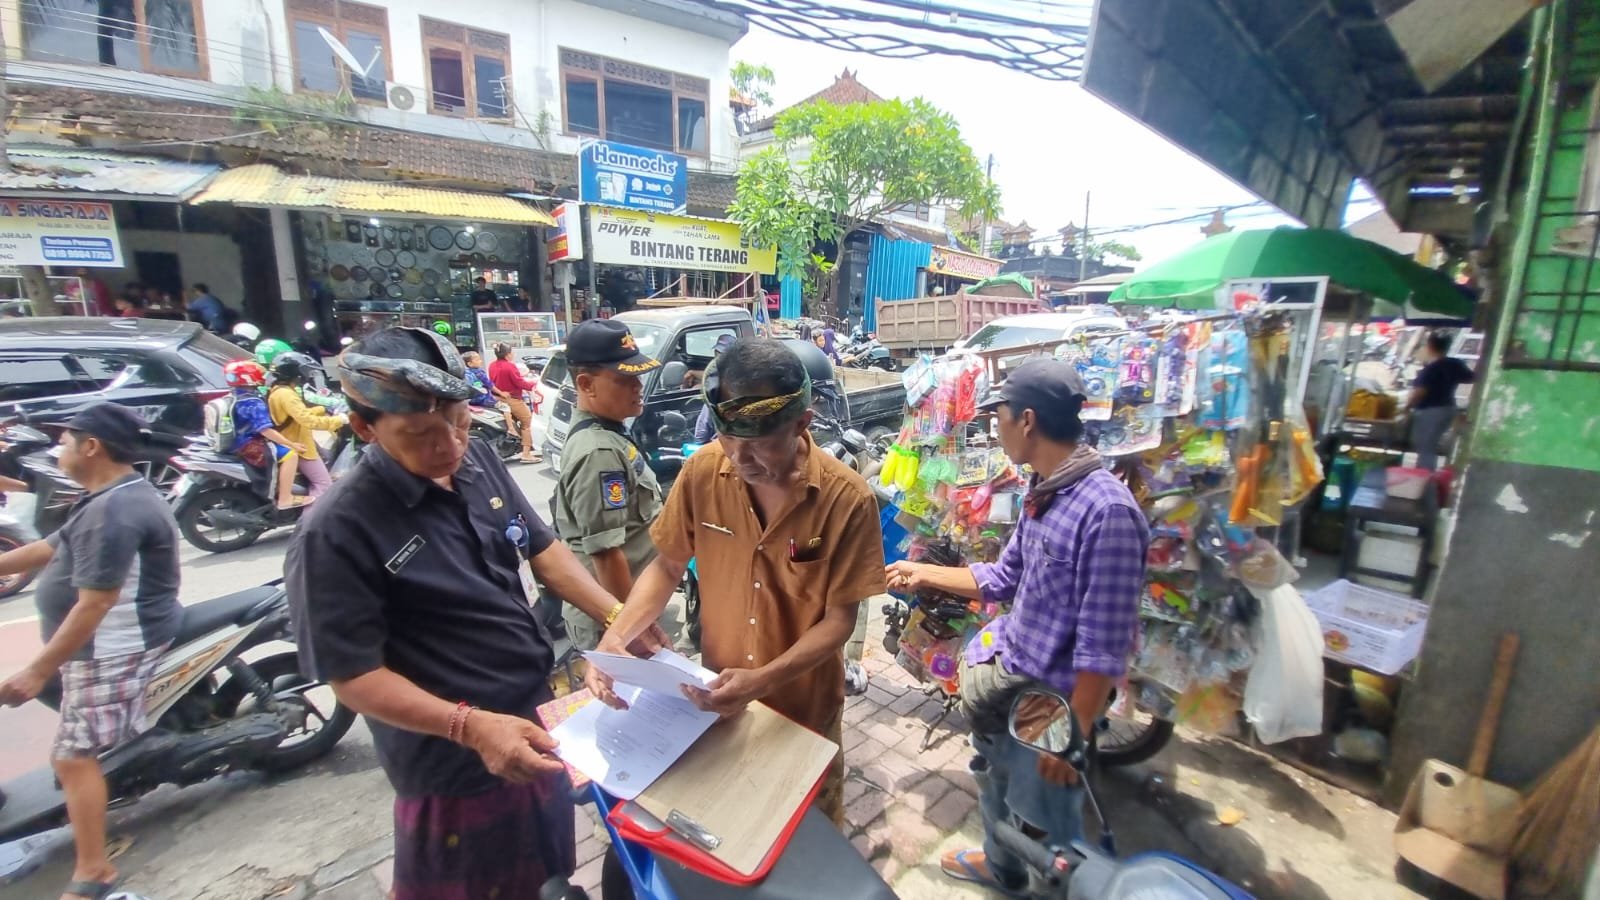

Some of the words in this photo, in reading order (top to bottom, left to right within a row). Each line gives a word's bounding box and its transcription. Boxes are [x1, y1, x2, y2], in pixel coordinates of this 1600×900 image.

[593, 143, 676, 176] Hannochs
[17, 203, 109, 220] SINGARAJA
[598, 222, 651, 237] POWER
[630, 240, 694, 261] BINTANG
[698, 246, 748, 265] TERANG
